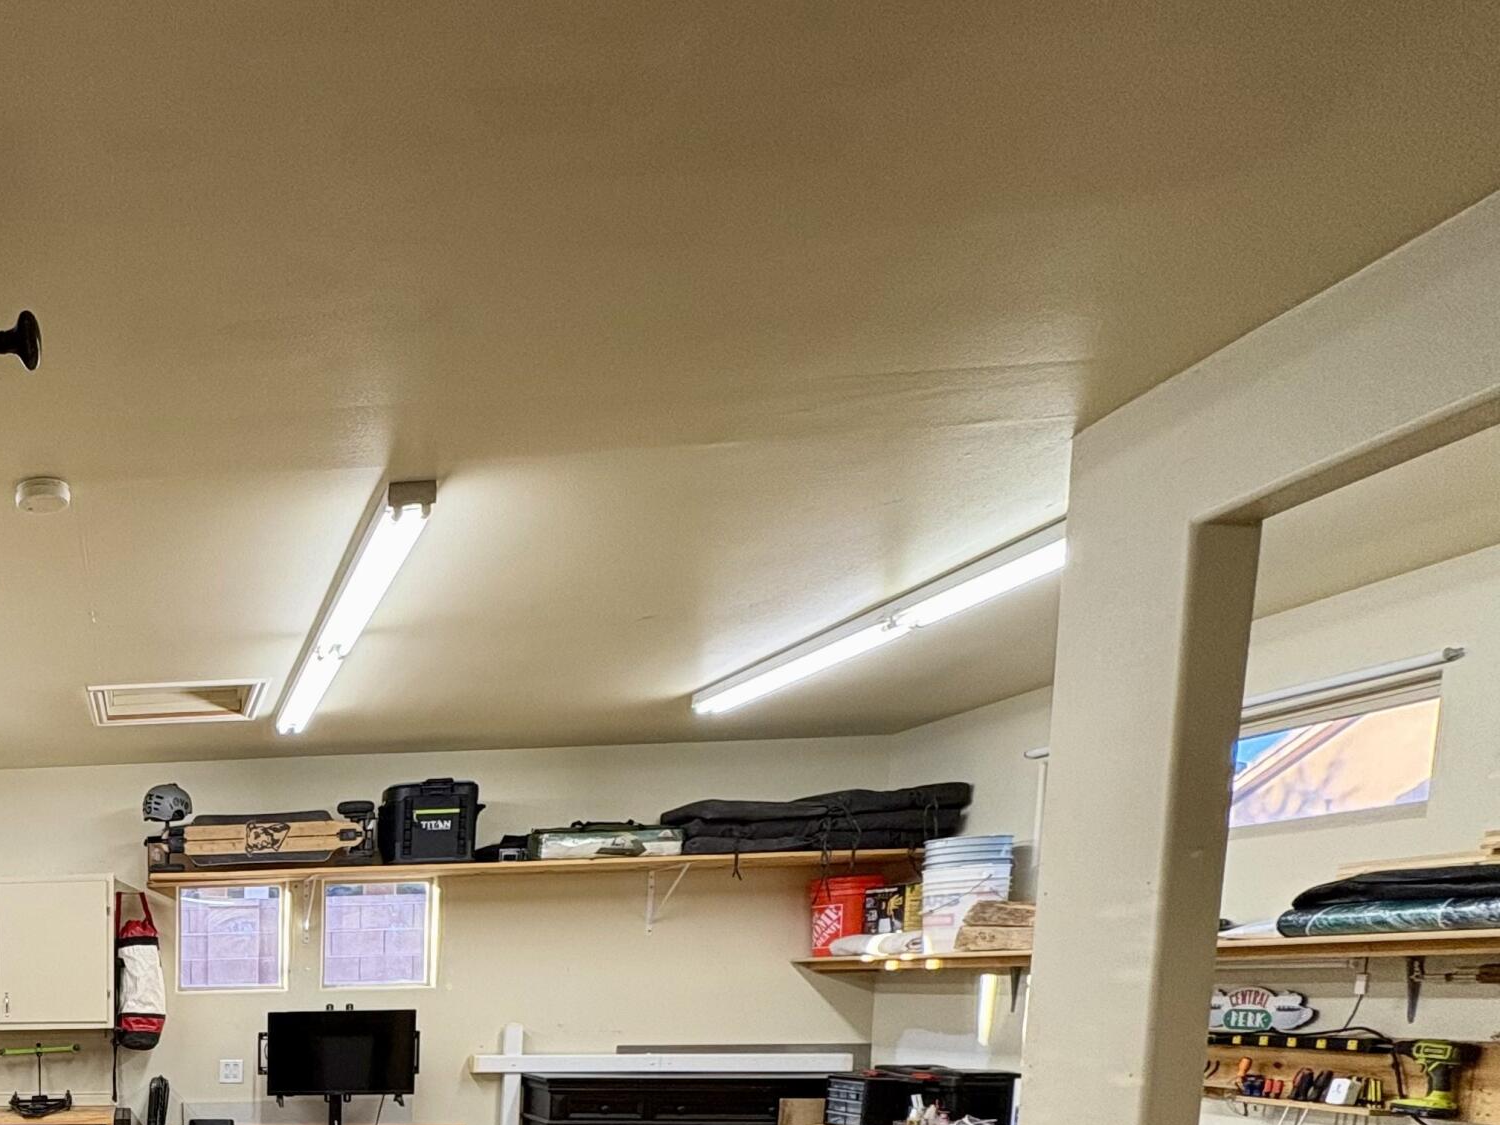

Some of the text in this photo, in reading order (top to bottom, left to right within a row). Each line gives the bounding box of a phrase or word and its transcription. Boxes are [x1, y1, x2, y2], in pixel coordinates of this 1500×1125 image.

[420, 819, 452, 831] TITAN
[1229, 989, 1270, 1009] CENTRAL
[1230, 1010, 1267, 1029] PERK
